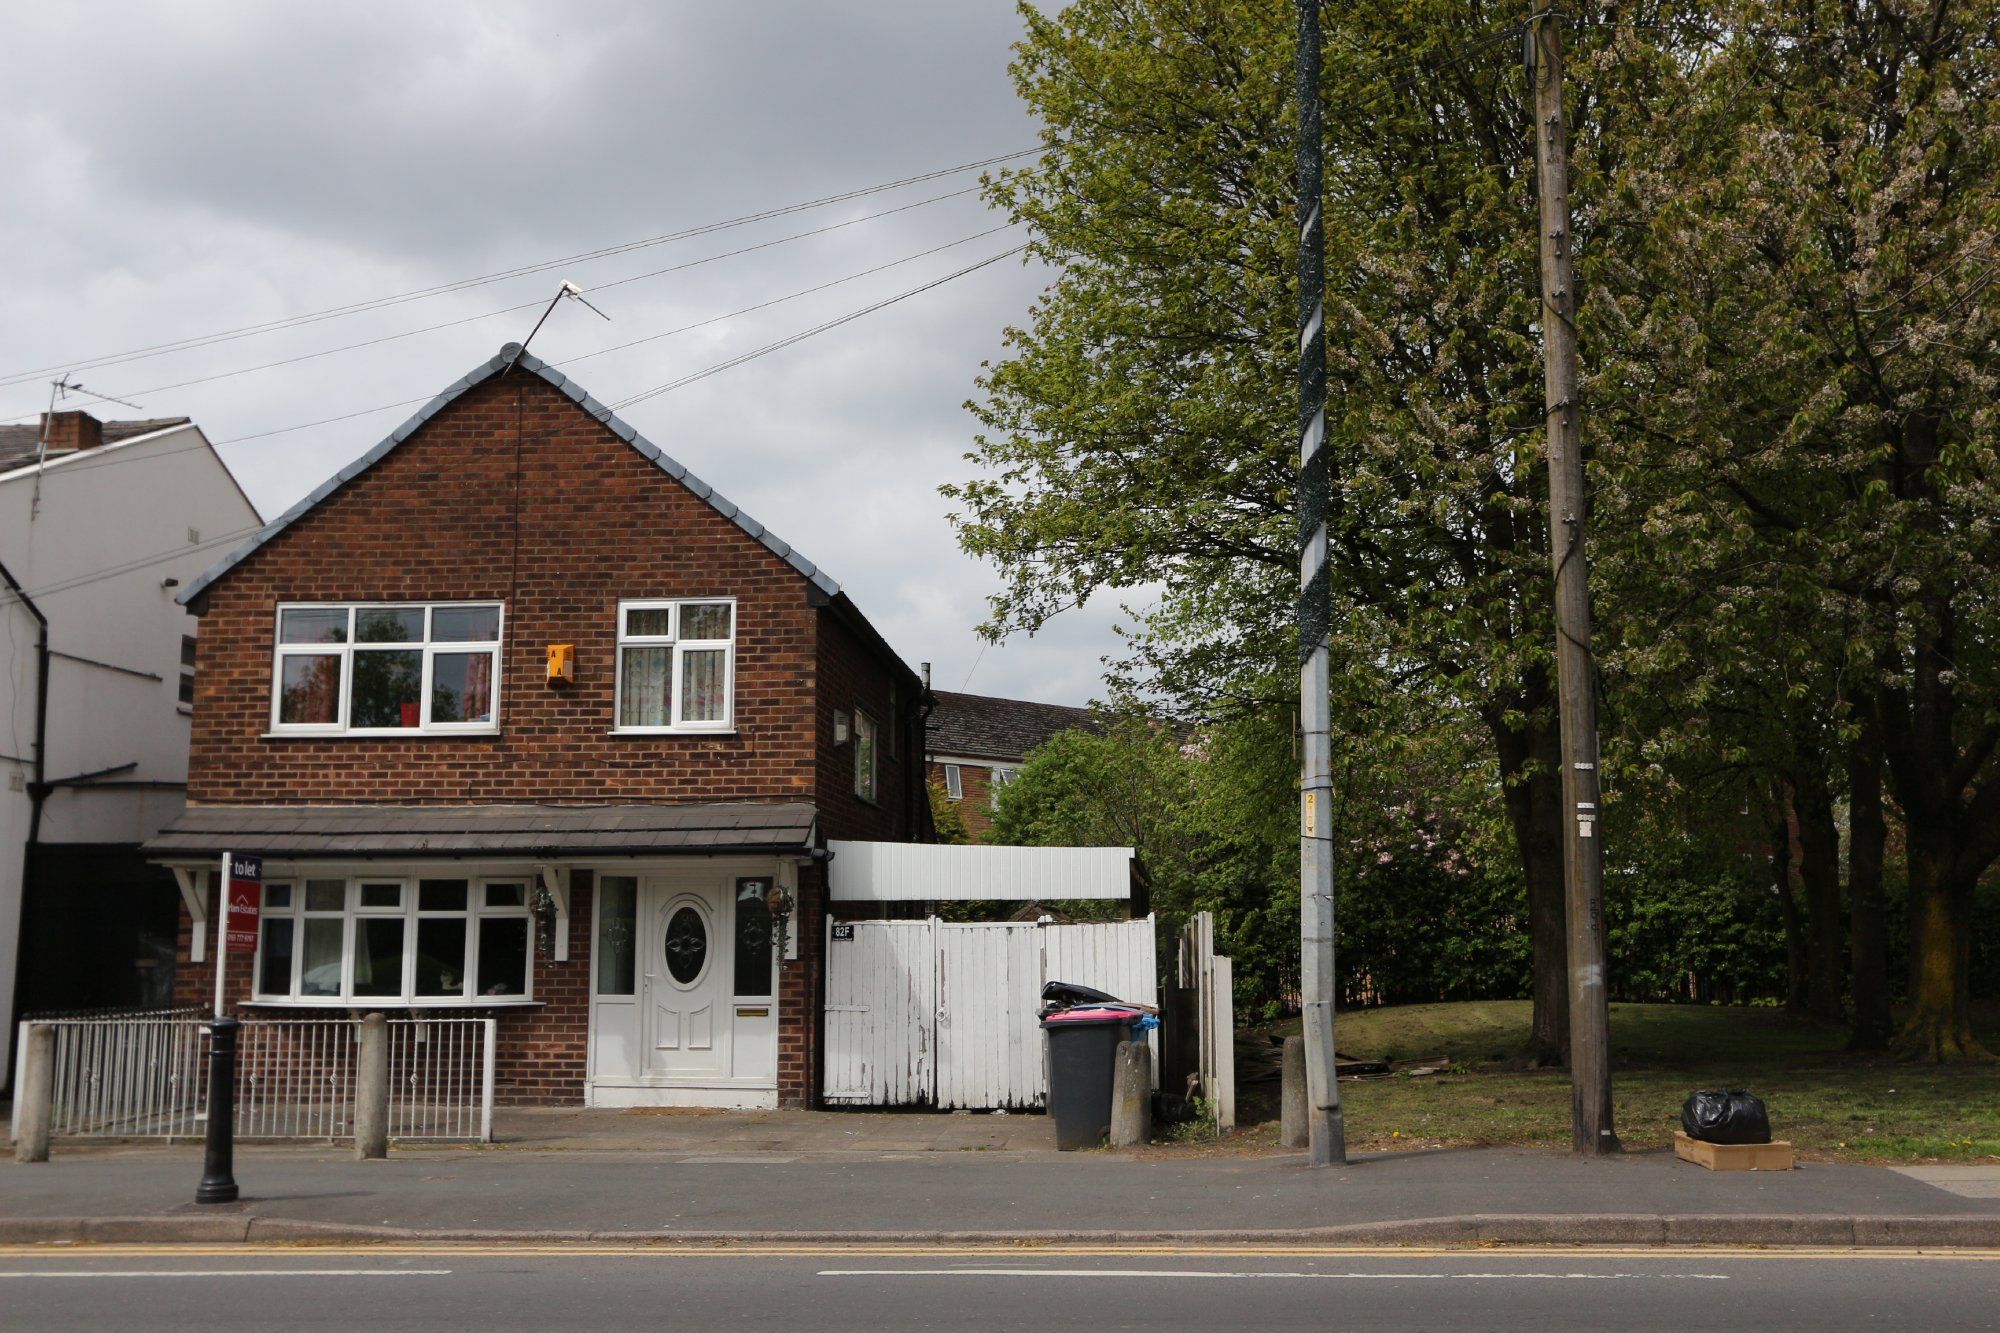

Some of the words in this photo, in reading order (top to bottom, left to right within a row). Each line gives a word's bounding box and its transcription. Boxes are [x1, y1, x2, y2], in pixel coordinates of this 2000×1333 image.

[235, 861, 244, 875] to
[244, 860, 256, 877] let
[836, 926, 850, 937] 82F
